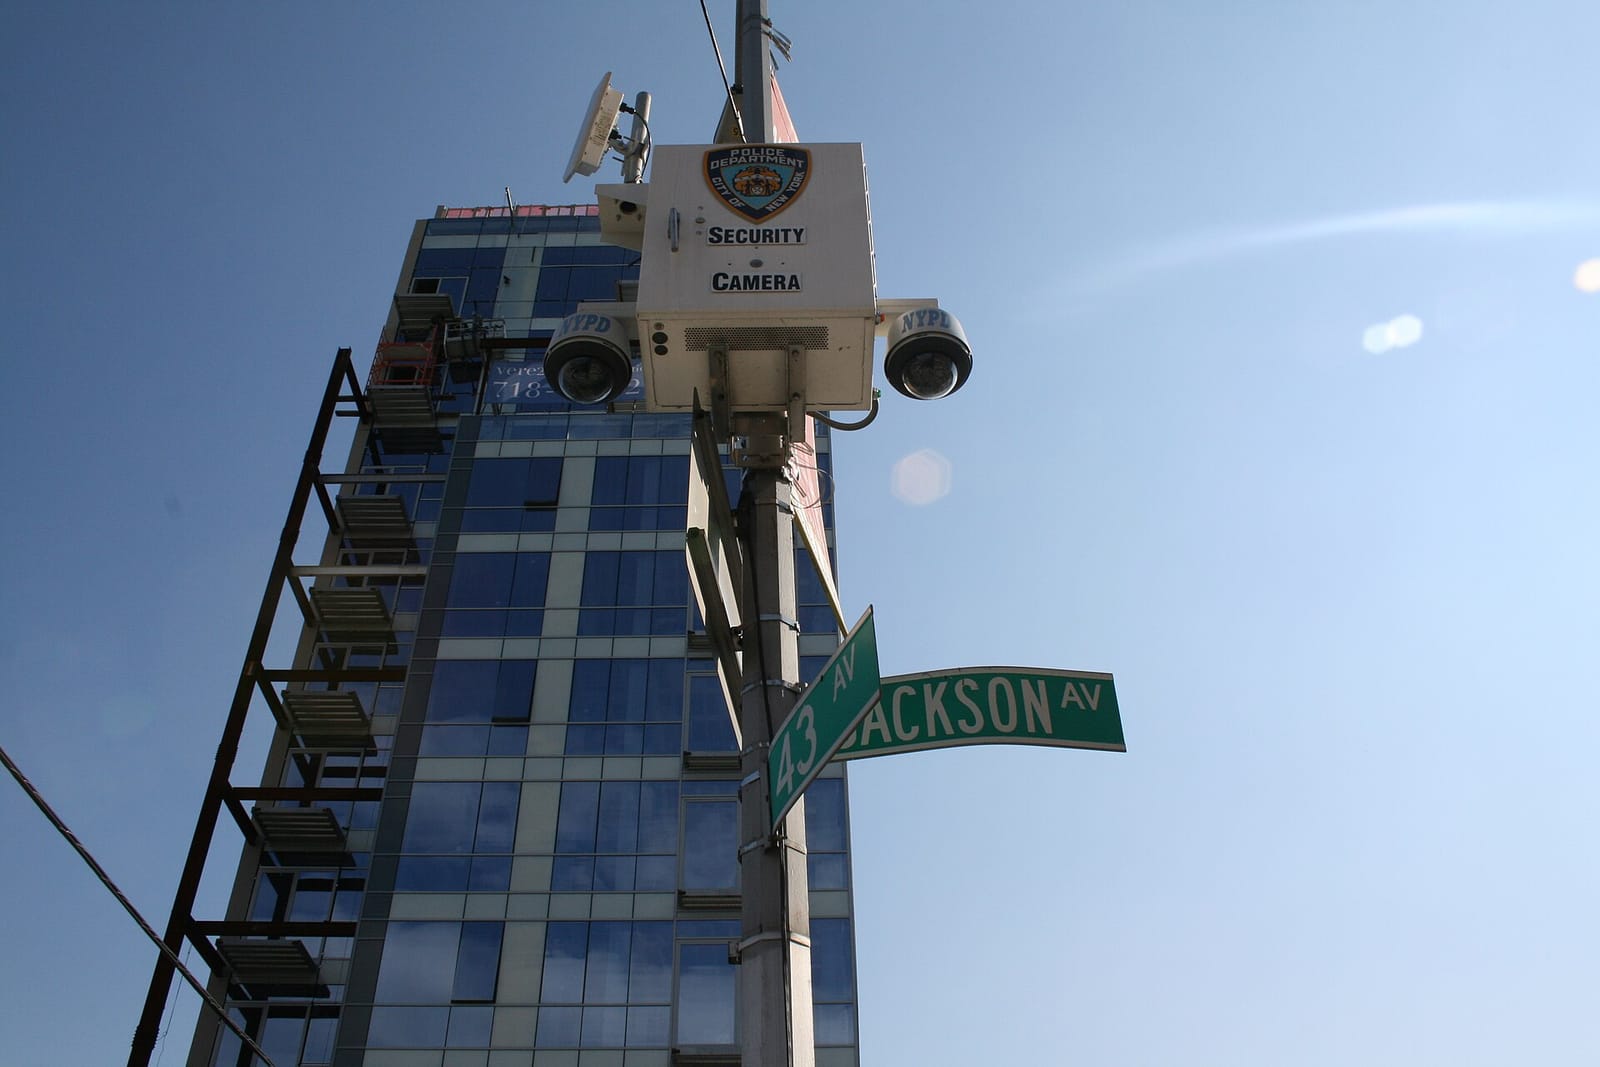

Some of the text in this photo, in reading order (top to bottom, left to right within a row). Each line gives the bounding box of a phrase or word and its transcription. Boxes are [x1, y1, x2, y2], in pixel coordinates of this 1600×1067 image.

[730, 148, 785, 157] POLICE
[710, 155, 804, 170] DEPARTMENT
[712, 171, 806, 212] CITY OF NEW YORK
[708, 227, 805, 244] SECURITY
[712, 272, 801, 291] CAMERA
[776, 643, 856, 796] 43 AV
[840, 677, 1101, 749] ACKSON AV
